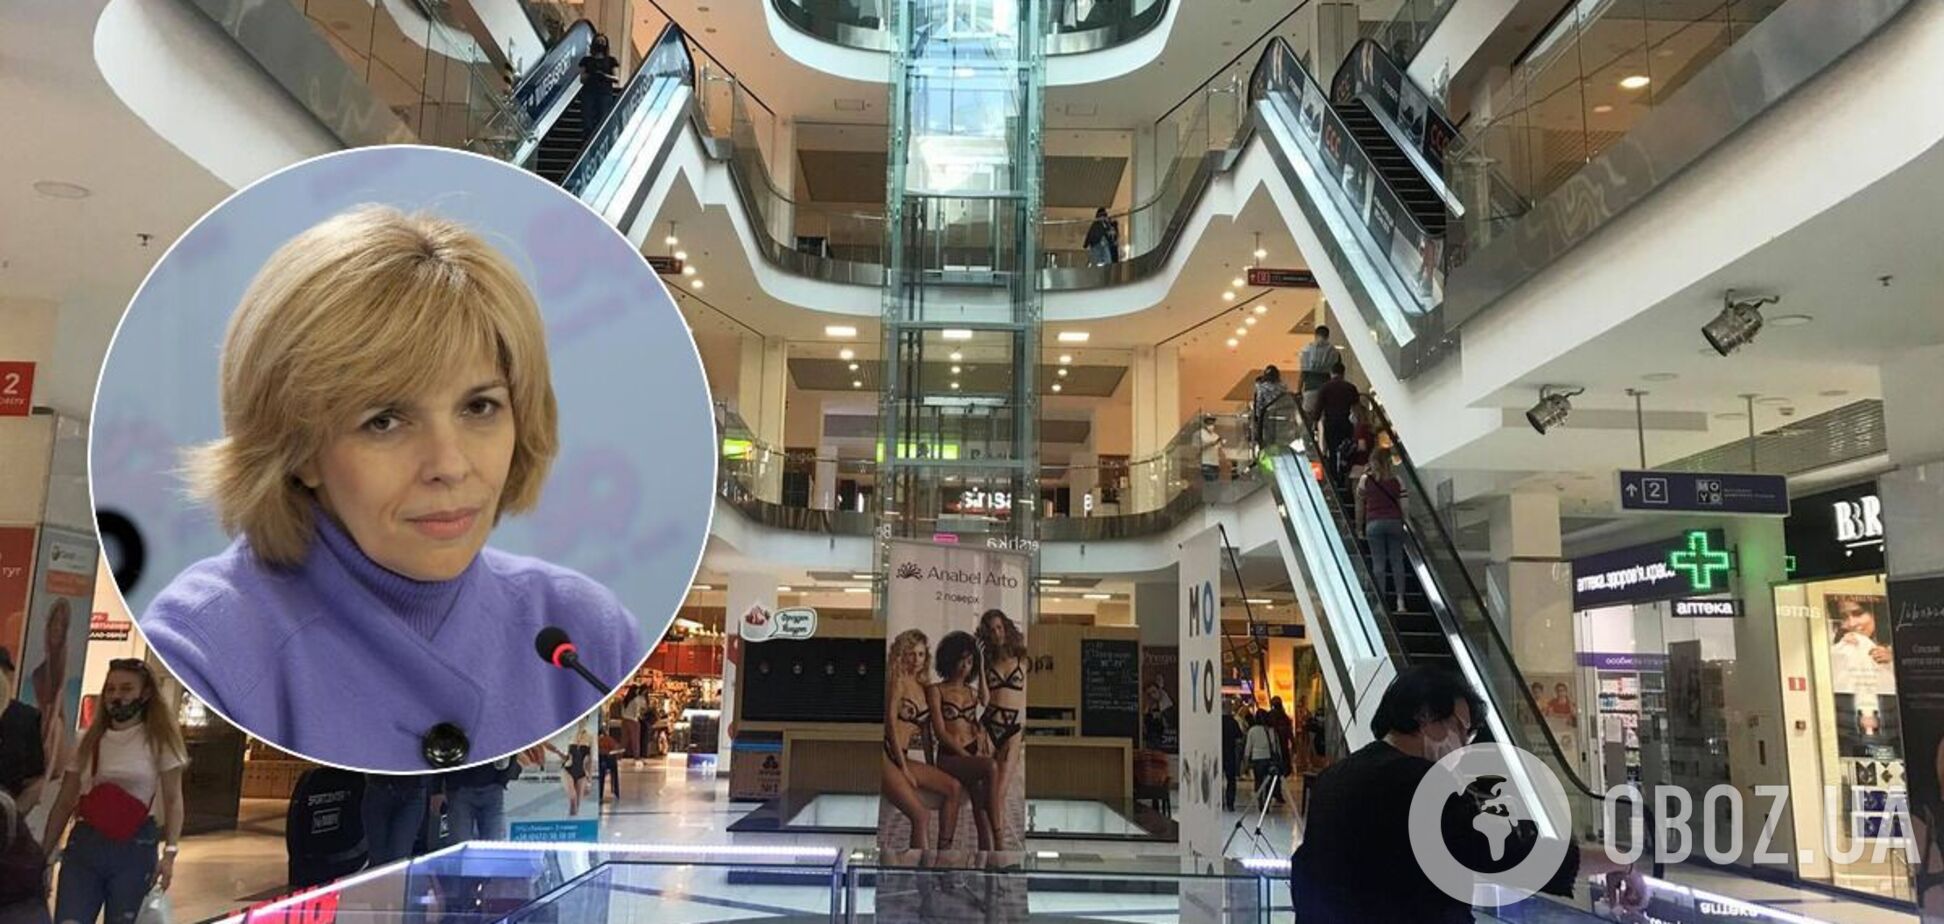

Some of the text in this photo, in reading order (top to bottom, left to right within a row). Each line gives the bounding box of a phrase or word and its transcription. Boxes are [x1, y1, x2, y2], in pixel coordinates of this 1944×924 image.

[3, 372, 20, 395] 2
[1649, 482, 1661, 498] 2
[926, 565, 1019, 589] Anabel Arto
[935, 591, 980, 606] 2 поверх
[1676, 602, 1734, 616] аптека
